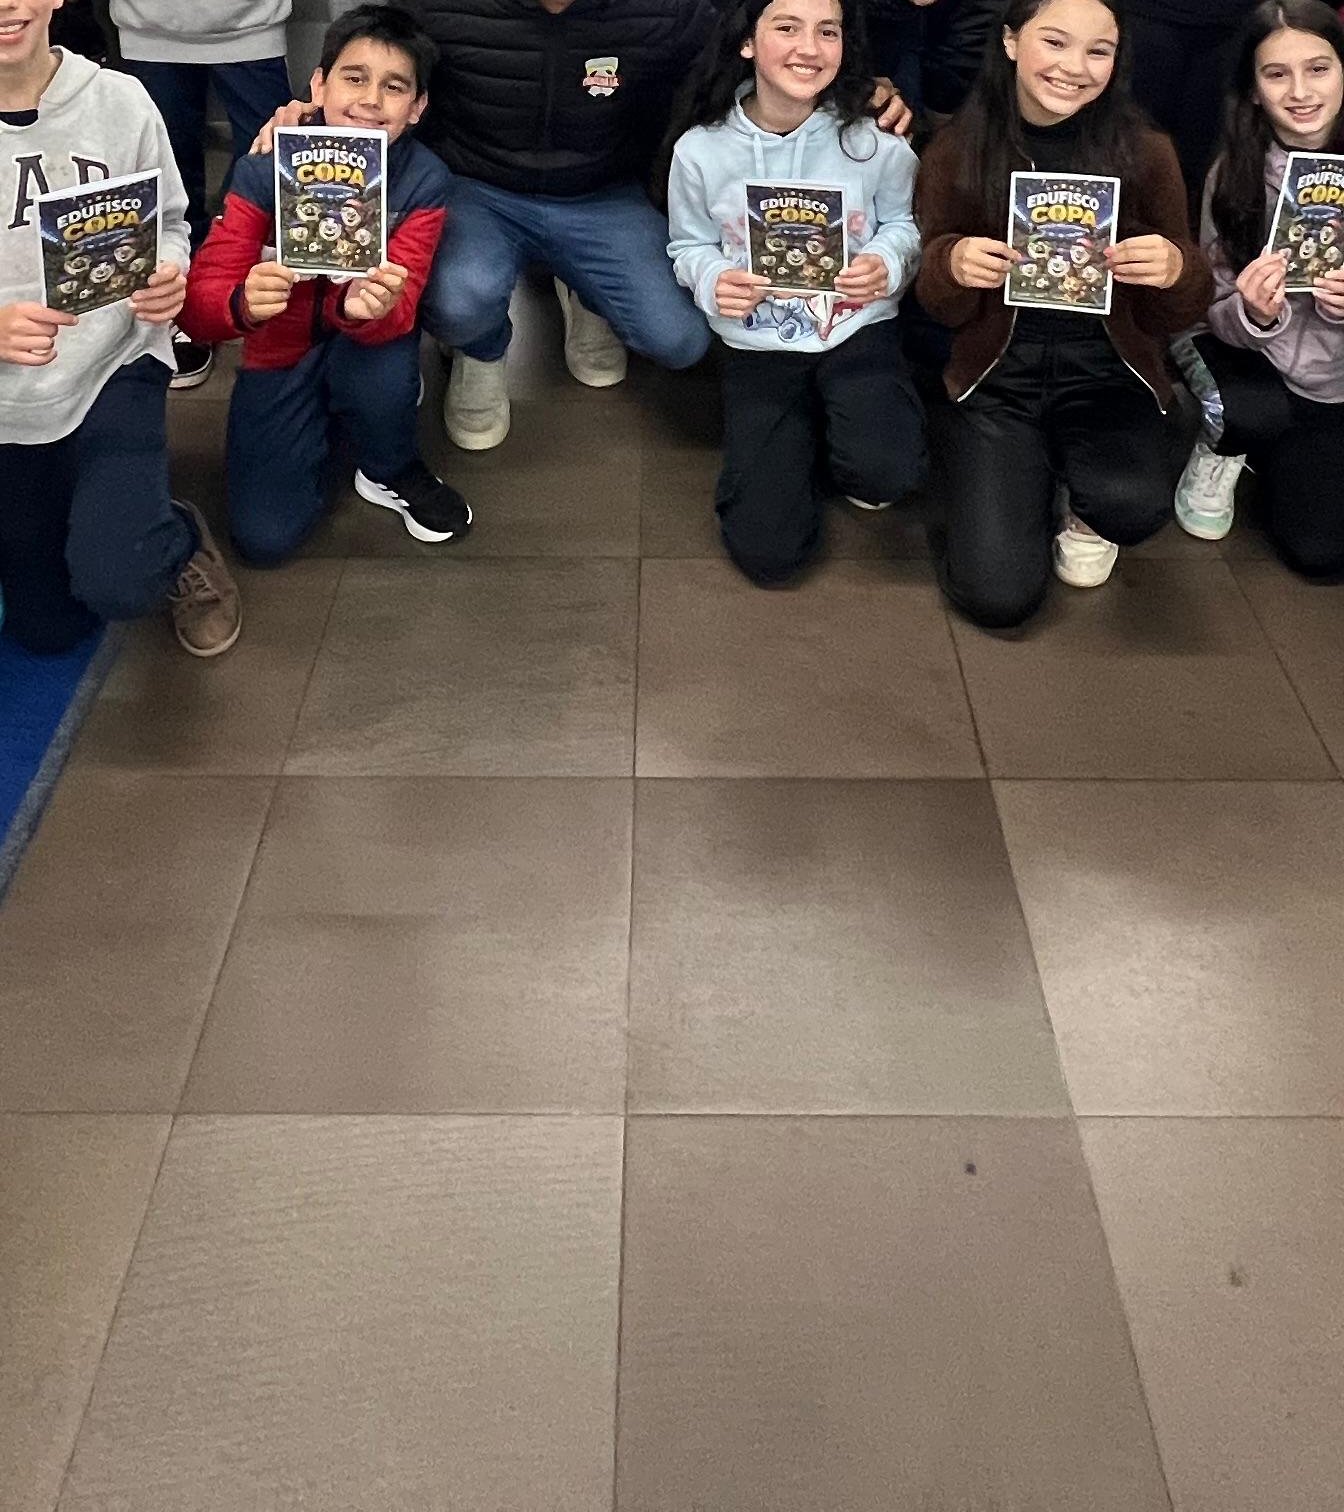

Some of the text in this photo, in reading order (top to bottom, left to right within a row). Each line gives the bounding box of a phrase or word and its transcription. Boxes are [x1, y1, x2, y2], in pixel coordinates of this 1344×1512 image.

[291, 148, 368, 170] EDUFISCO
[297, 162, 366, 187] COPA
[759, 197, 830, 214] EDUFISCO
[1026, 190, 1100, 211] EDUFISCO
[56, 197, 142, 230] EDUFISCO
[764, 207, 828, 226] COPA
[1030, 204, 1097, 228] COPA
[62, 210, 141, 241] COPA
